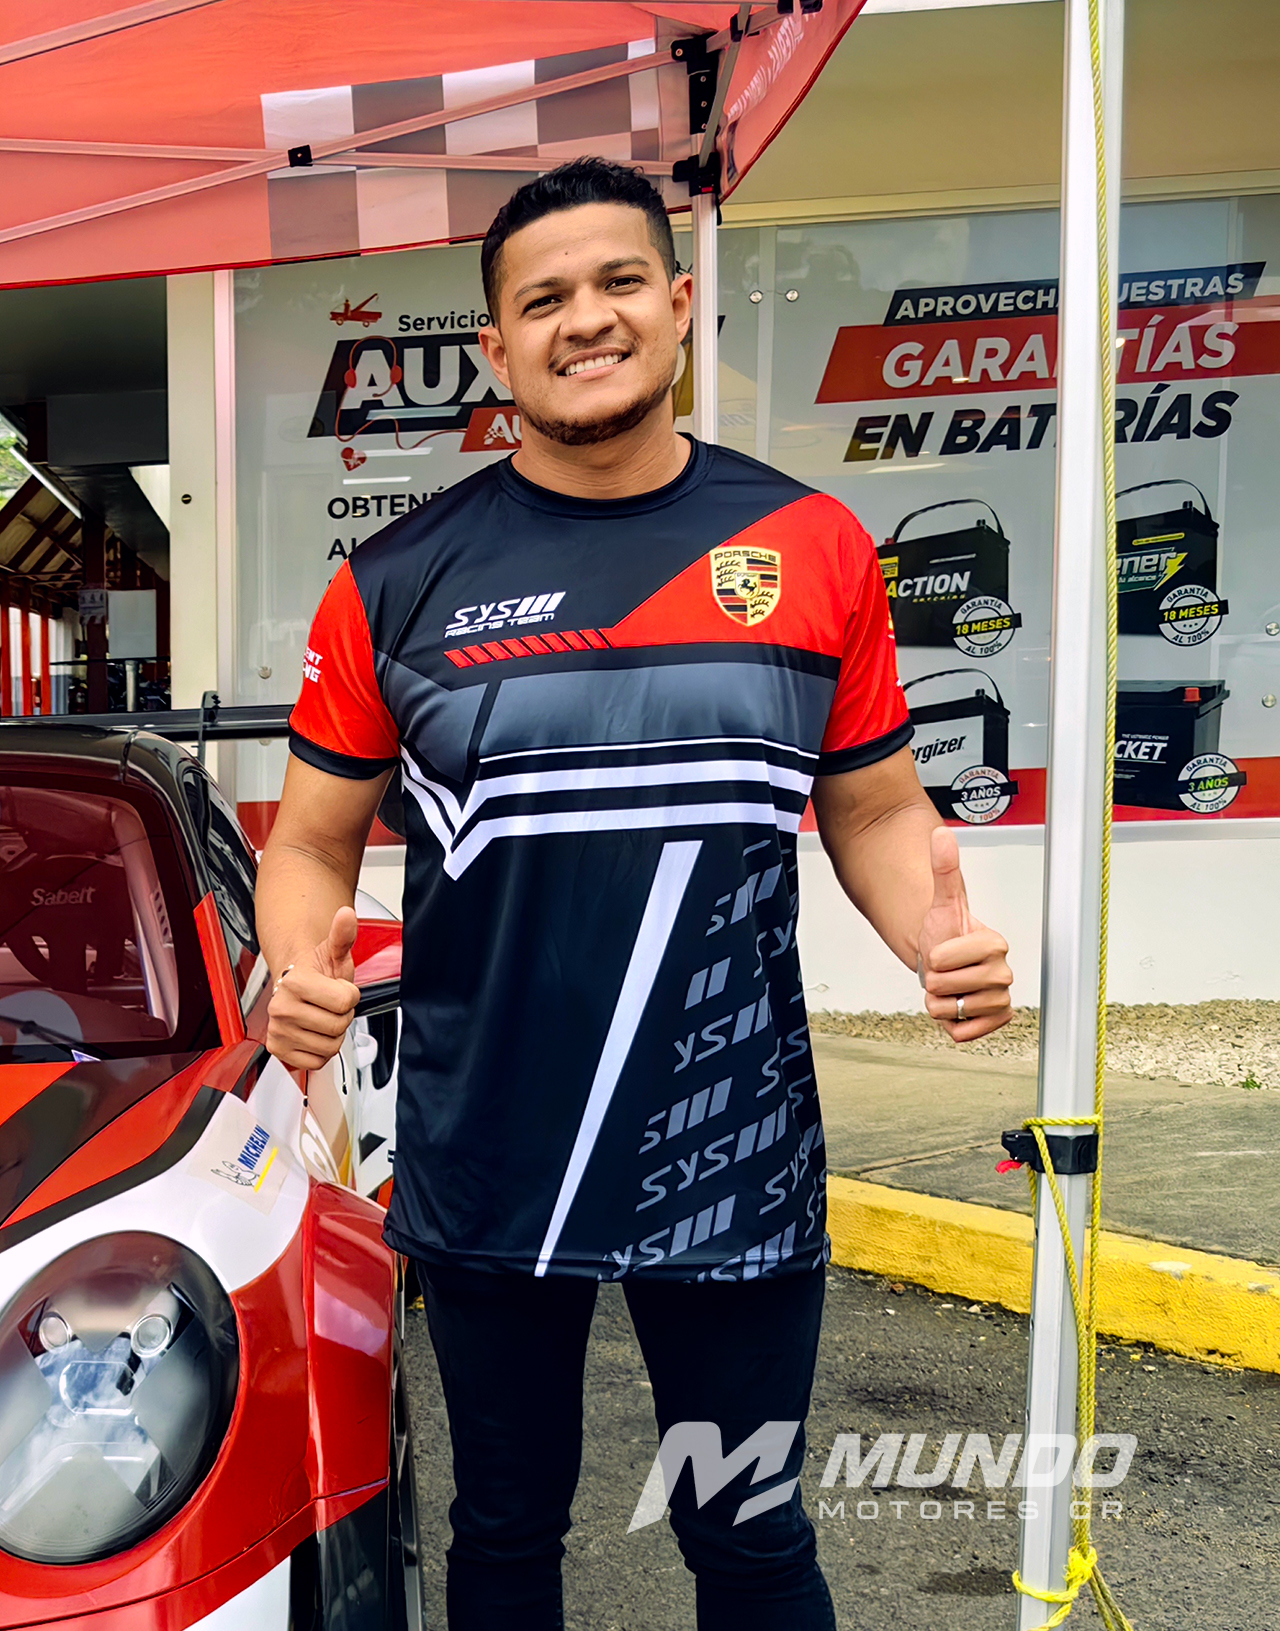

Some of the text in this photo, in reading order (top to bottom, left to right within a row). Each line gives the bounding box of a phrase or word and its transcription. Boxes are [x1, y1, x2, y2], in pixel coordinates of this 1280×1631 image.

[895, 273, 1245, 321] APROVECH UESTRAS
[398, 310, 491, 332] Servicio
[882, 315, 1240, 388] GARATÍAS
[341, 343, 516, 410] AUX
[843, 383, 1240, 463] EN BATRÍAS
[327, 487, 445, 520] OBTEN
[714, 550, 777, 563] PORSCHE
[1163, 604, 1219, 622] 18 MESES
[955, 617, 1011, 635] 18 MESES
[1172, 629, 1210, 644] AL 100%
[965, 645, 976, 655] AL
[1114, 740, 1168, 761] CKET
[961, 786, 1001, 801] 3 AÑOS
[1197, 776, 1229, 791] AÑOS
[237, 1123, 271, 1171] MICHELIN
